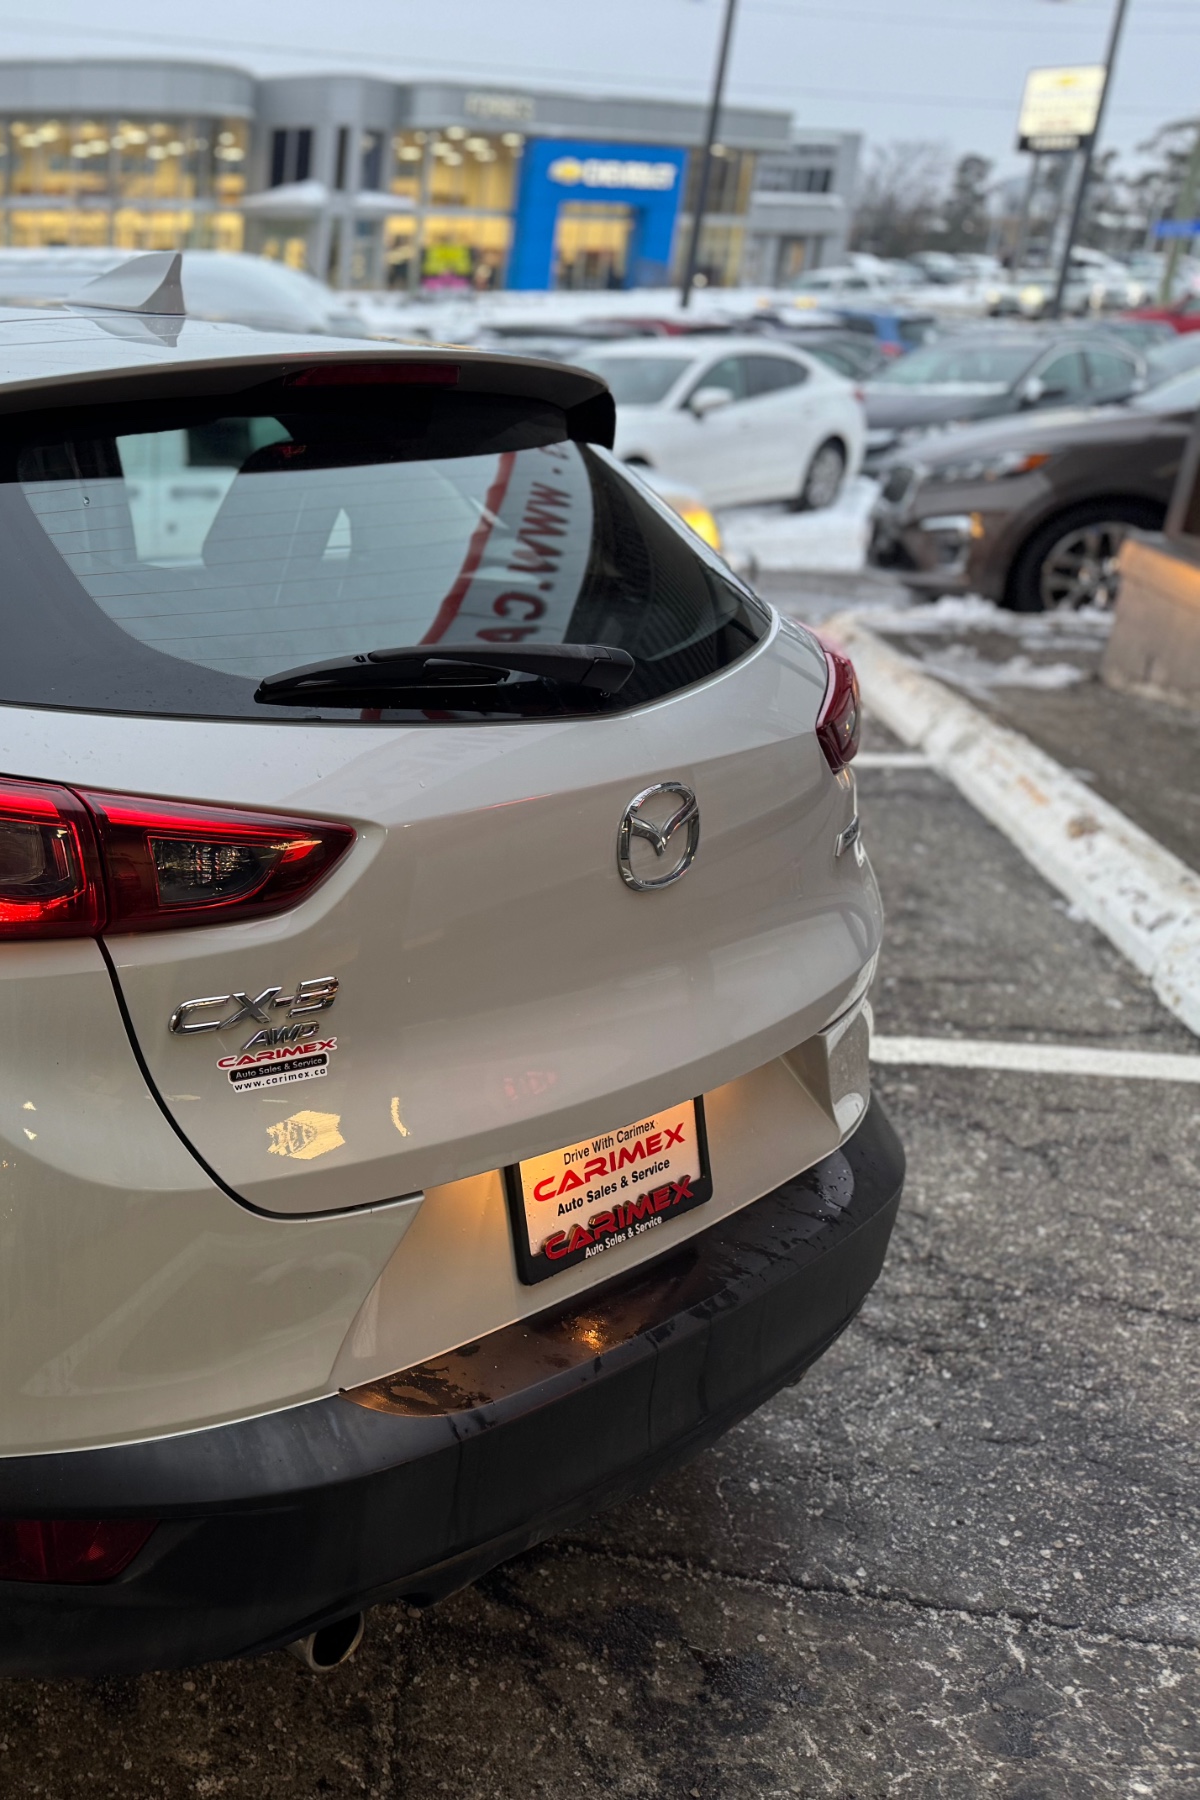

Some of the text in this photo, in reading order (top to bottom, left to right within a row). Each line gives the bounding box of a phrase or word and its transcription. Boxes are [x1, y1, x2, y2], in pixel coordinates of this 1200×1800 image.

[168, 976, 339, 1035] CX-3
[217, 1039, 336, 1068] CARIMEX
[242, 1020, 320, 1050] AWD
[234, 1067, 327, 1092] www.carimex.ca
[235, 1056, 323, 1080] Auto Sales & Service
[533, 1122, 686, 1202] CARIMEX
[564, 1119, 655, 1166] Drive With Carimex
[557, 1159, 670, 1217] Auto Sales & Service
[544, 1174, 695, 1261] CARIMEX
[584, 1215, 663, 1259] Auto Sales & Service
